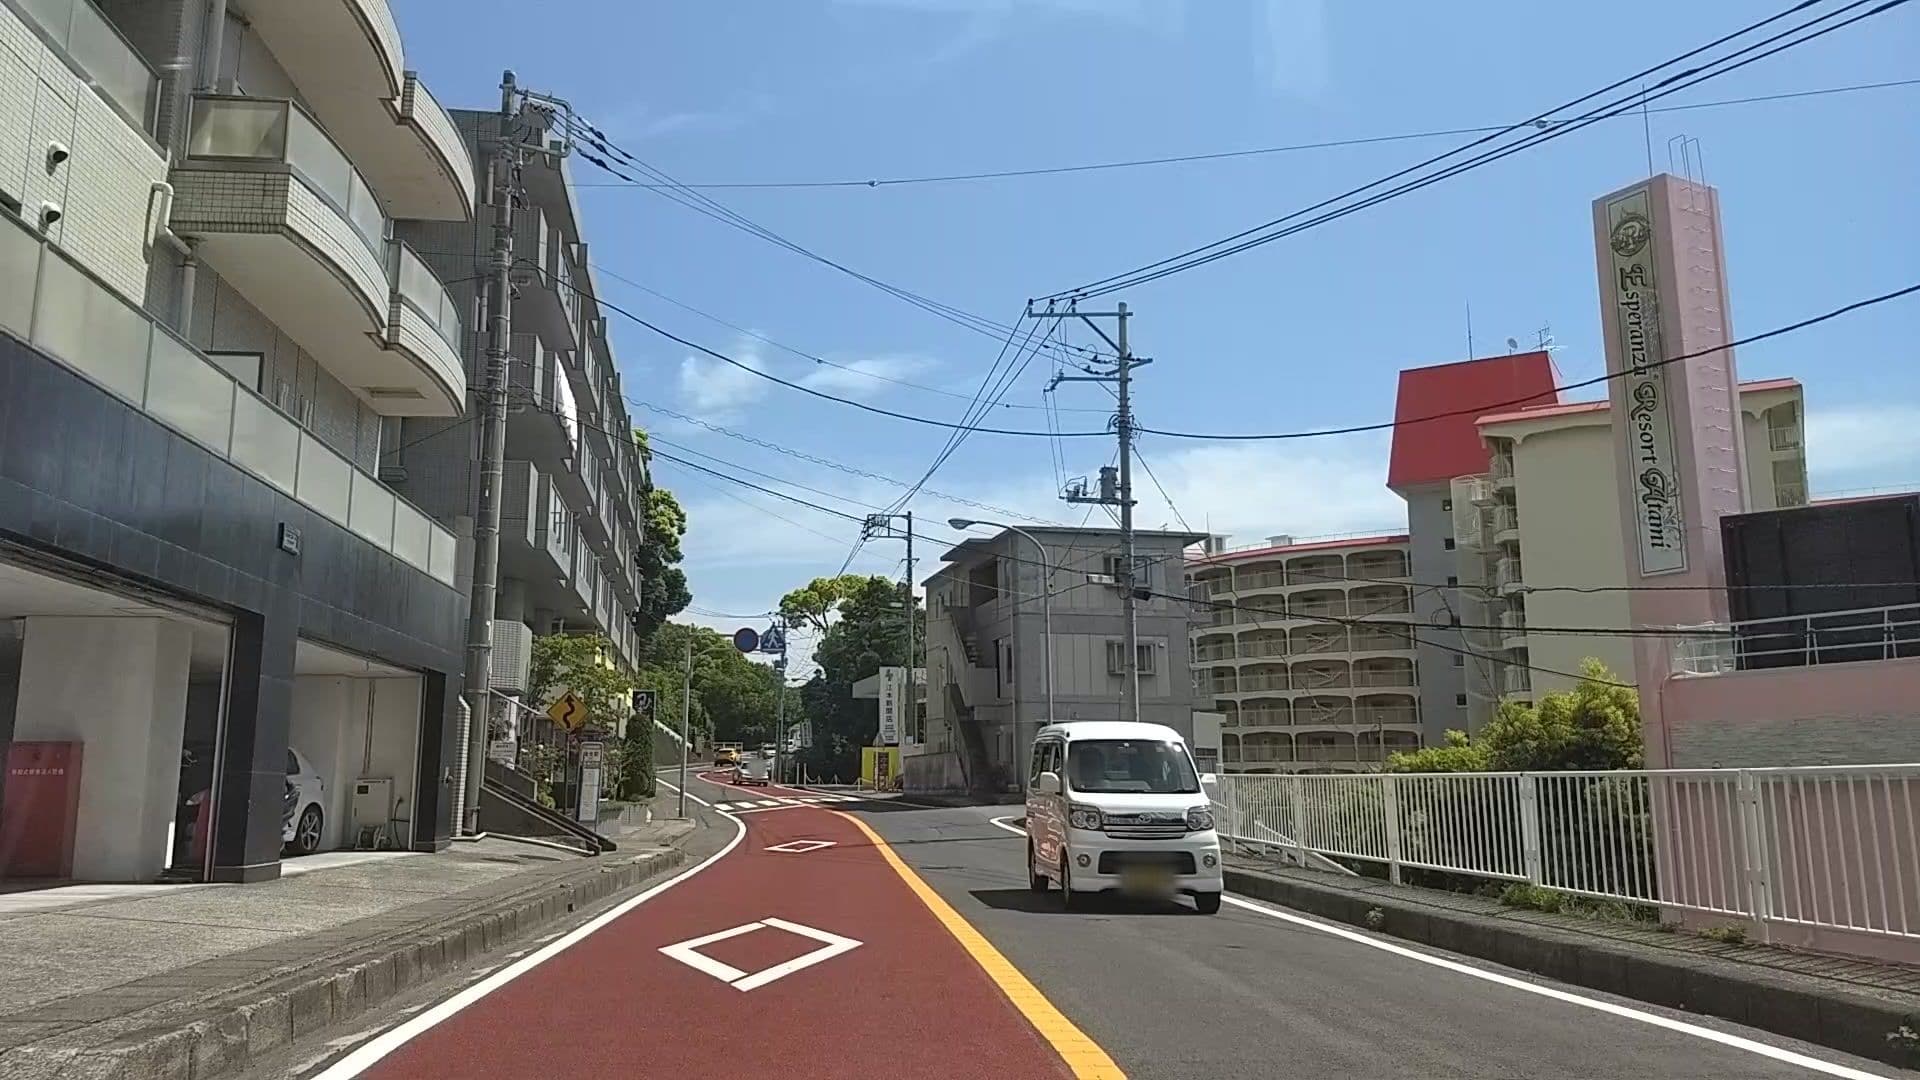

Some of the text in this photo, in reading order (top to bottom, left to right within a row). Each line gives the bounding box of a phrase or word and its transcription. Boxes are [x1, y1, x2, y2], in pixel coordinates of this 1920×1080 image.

[1620, 263, 1671, 549] Esperanza Resort Atami
